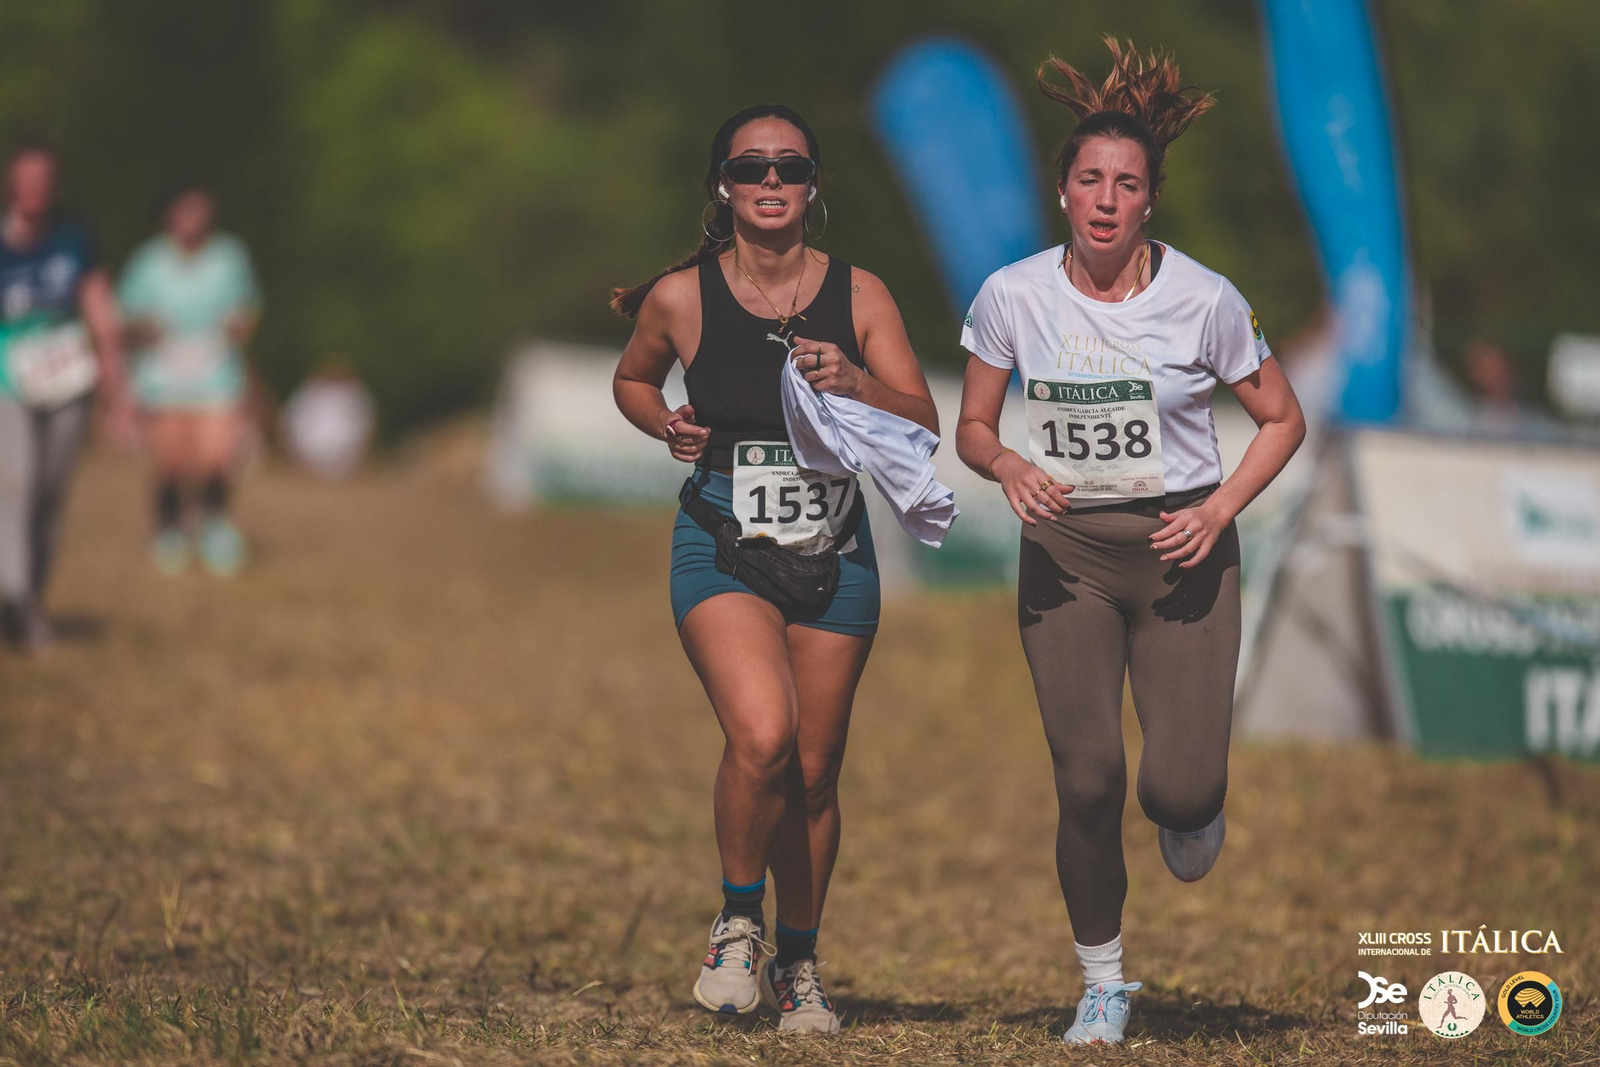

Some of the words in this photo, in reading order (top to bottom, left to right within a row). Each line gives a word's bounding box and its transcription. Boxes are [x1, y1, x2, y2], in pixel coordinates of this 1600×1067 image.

[1057, 351, 1152, 375] ITÁLICA
[1058, 385, 1119, 400] ITÁLICA
[1099, 405, 1125, 413] ALCAIDE
[1042, 420, 1152, 460] 1538
[749, 478, 851, 524] 1537
